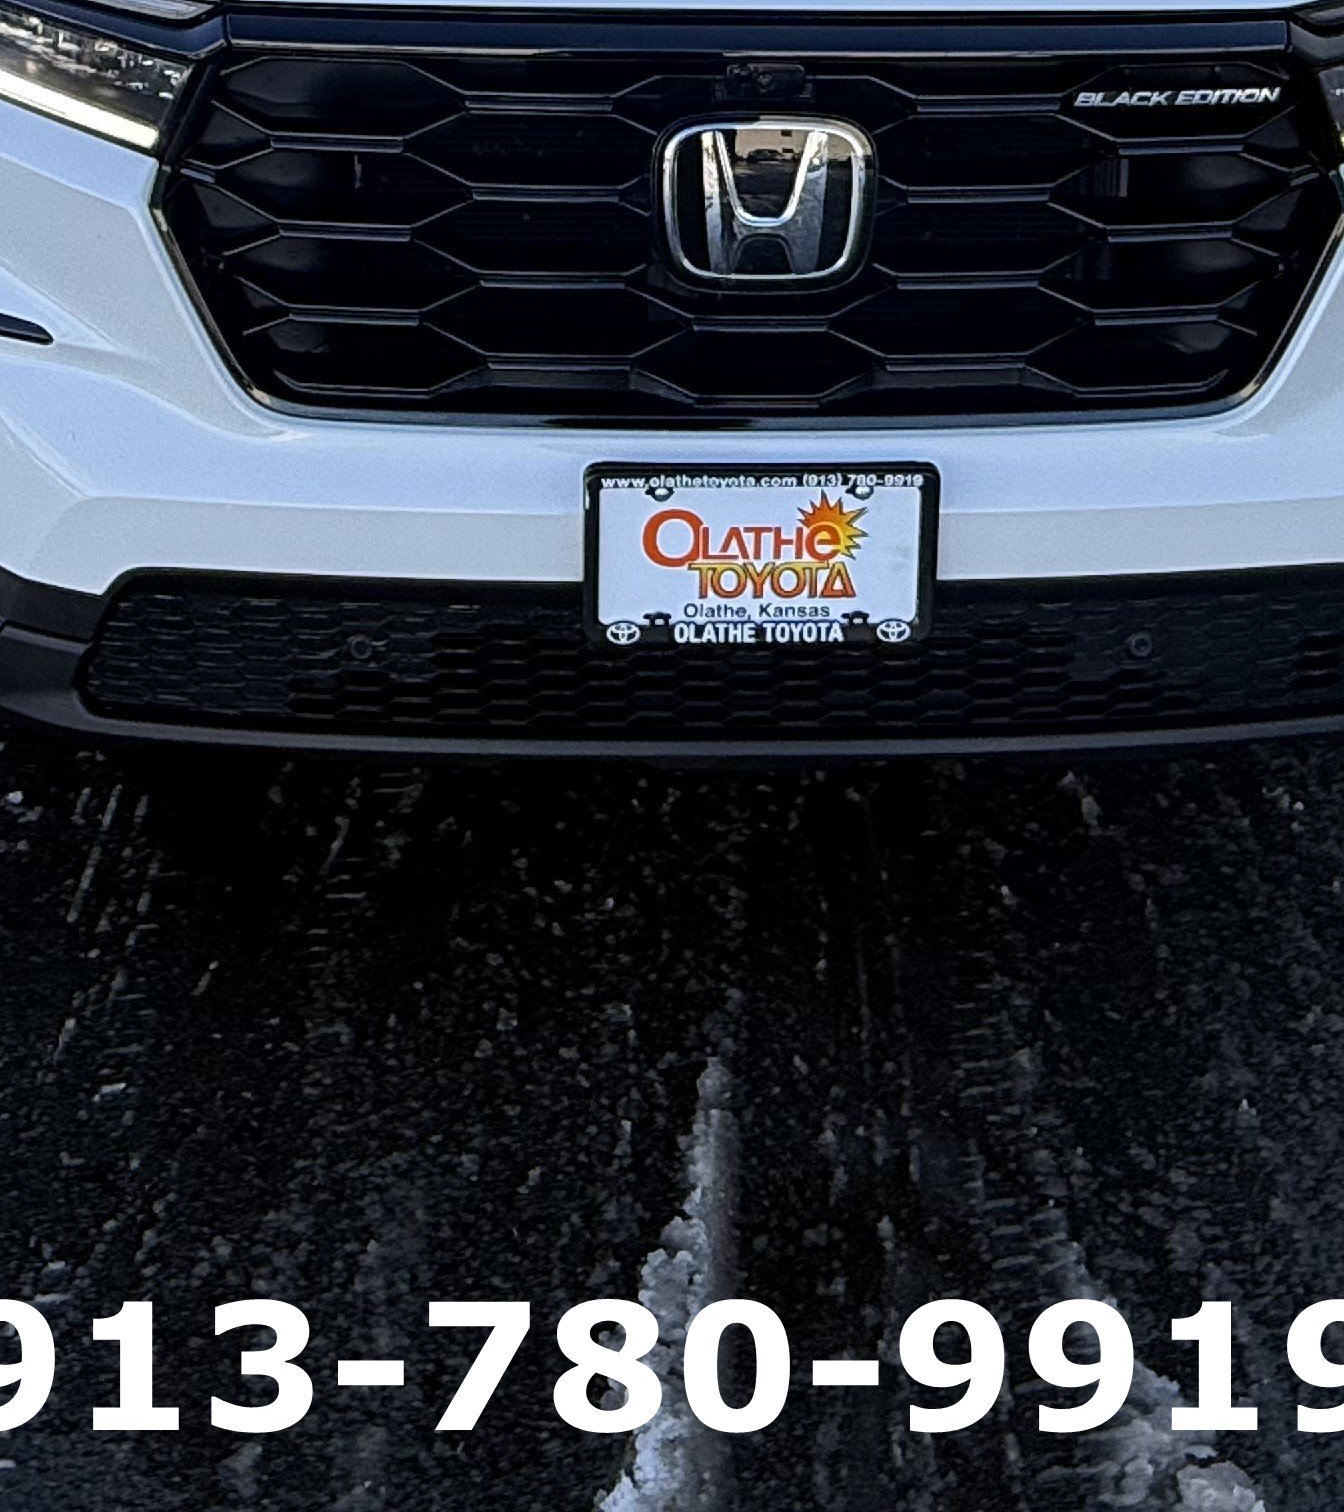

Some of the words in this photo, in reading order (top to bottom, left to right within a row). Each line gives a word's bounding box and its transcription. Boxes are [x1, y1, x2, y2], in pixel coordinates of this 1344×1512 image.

[1074, 91, 1171, 107] BLACK
[1174, 87, 1281, 106] EDITION
[600, 474, 797, 489] www.olathetoyota.com
[687, 561, 857, 600] TOYOTA
[683, 602, 751, 621] Olathe,
[759, 602, 830, 619] Kansas
[673, 621, 757, 644] OLATHE
[764, 621, 845, 643] TOYOTA
